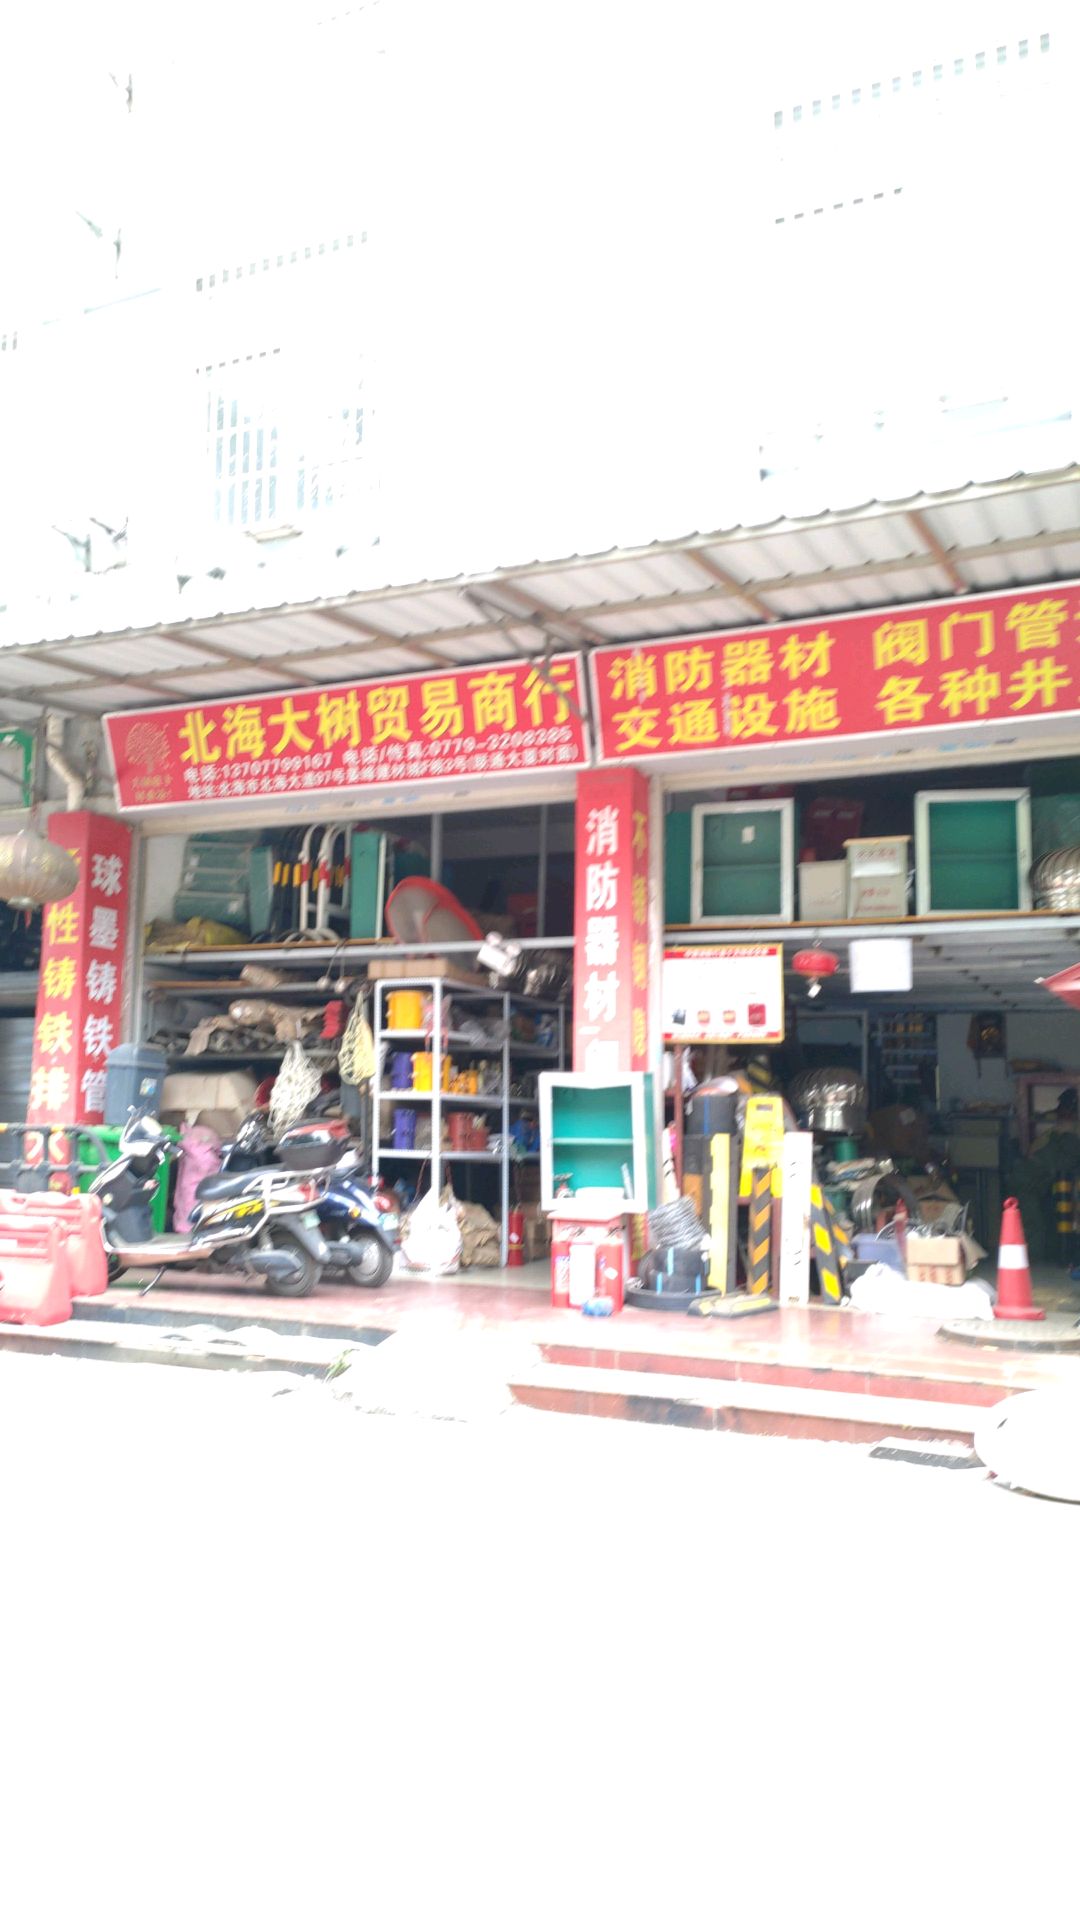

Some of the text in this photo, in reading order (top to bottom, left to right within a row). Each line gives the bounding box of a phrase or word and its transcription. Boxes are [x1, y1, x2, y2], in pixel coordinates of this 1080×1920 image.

[608, 599, 1080, 701] 消防器材 阀门管
[179, 664, 575, 766] 北海大树贸易商行
[611, 656, 1080, 752] 交通设施 各种井
[82, 855, 122, 1112] 球墨铸铁管
